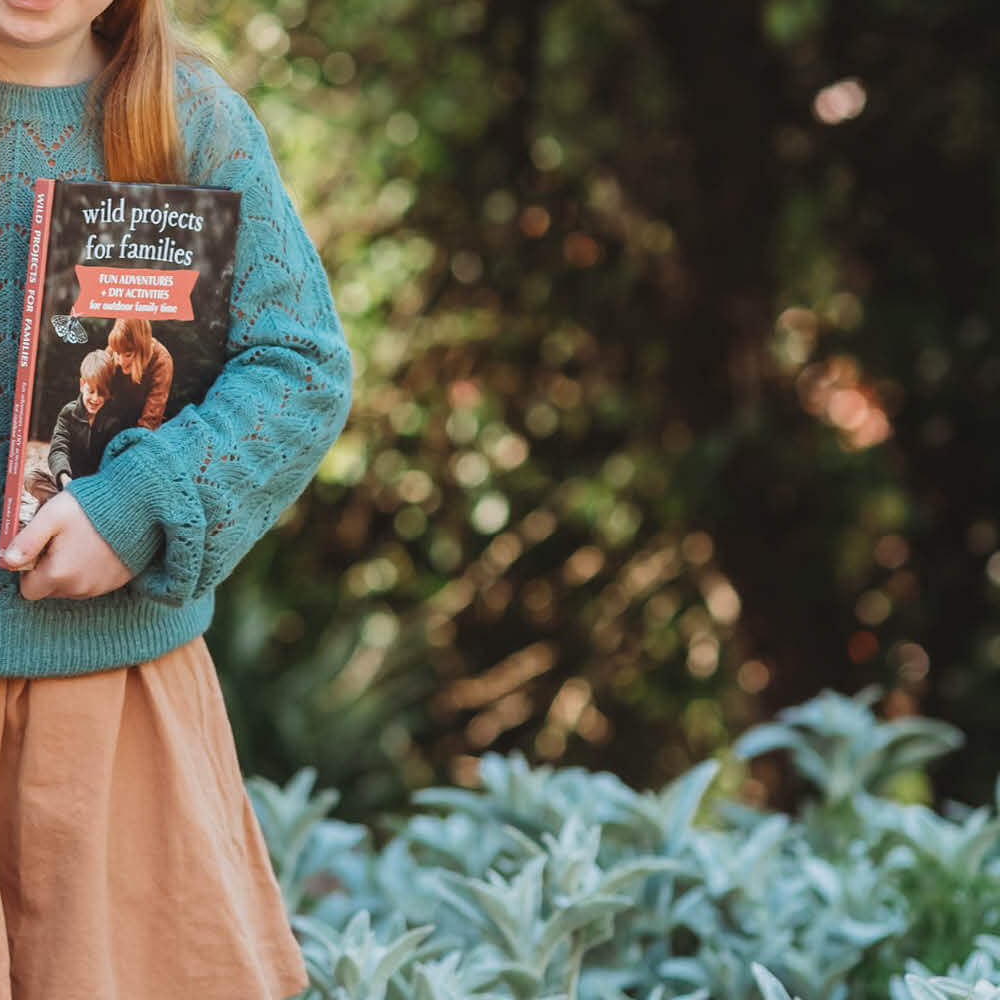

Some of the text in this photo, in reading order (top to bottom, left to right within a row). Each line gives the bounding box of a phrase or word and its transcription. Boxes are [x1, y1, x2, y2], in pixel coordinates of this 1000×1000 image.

[35, 193, 45, 224] WILD
[82, 198, 204, 232] wild projects
[29, 229, 41, 284] PROJECTS
[86, 233, 193, 266] for families
[99, 273, 174, 286] FUN ADVENTURES
[108, 287, 124, 297] DIY
[125, 287, 169, 299] ACTIVITIES
[25, 288, 36, 313] FOR
[89, 299, 101, 310] for
[20, 317, 33, 368] FAMILIES
